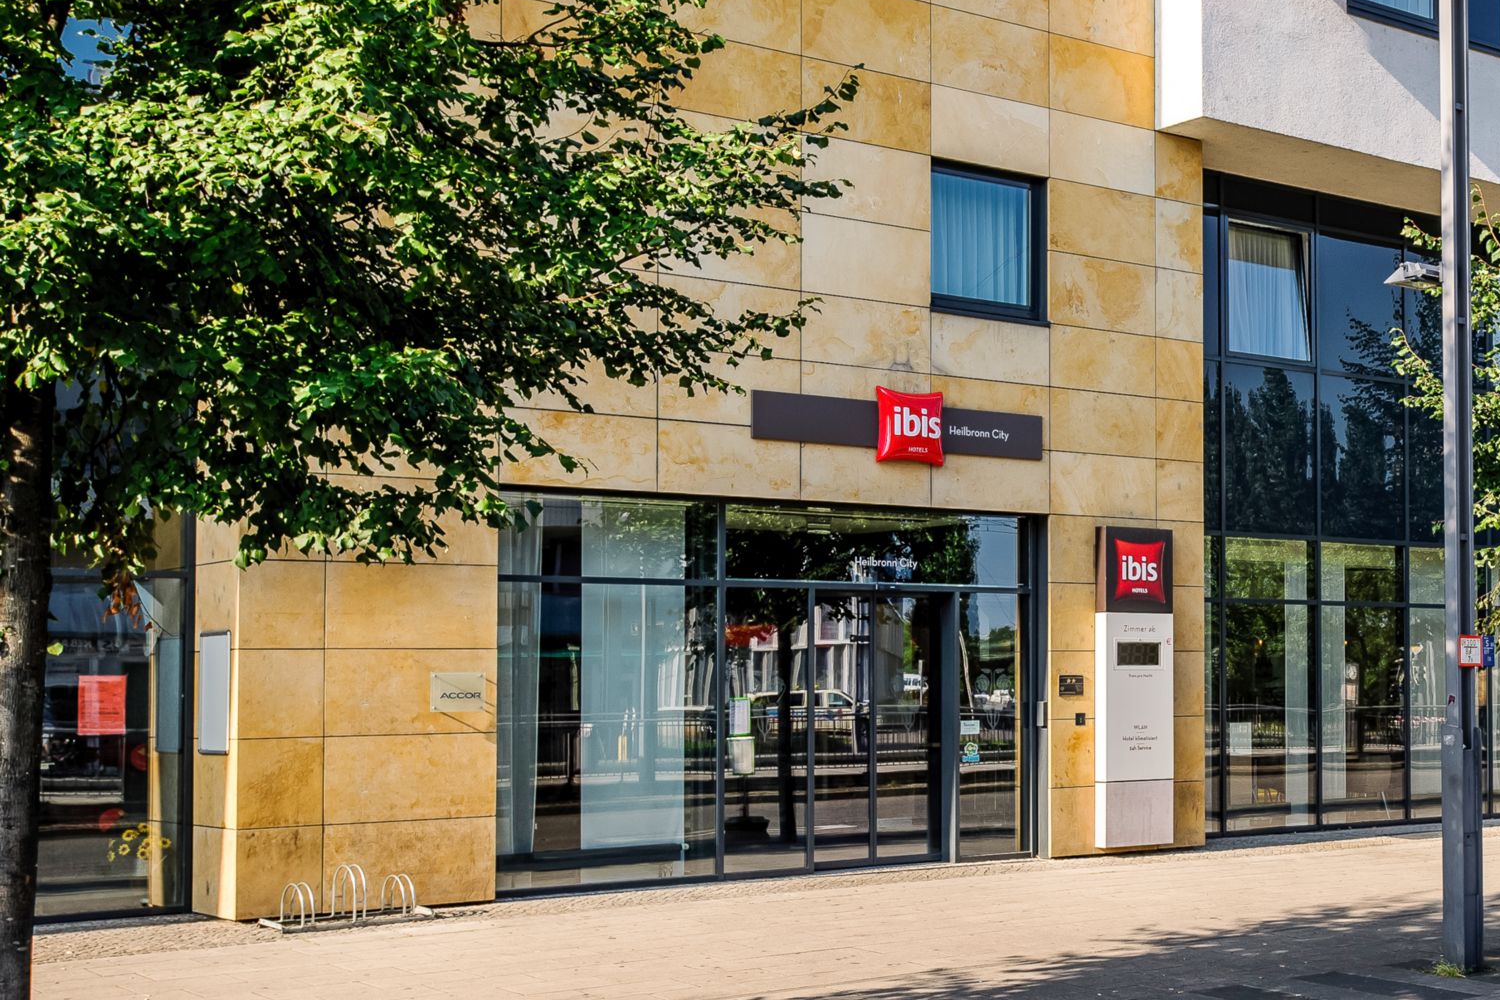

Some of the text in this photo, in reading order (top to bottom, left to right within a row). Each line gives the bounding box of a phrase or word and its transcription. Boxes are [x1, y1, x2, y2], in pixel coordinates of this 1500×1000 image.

[893, 406, 942, 439] ibis
[949, 425, 1010, 442] Heilbronn City
[854, 556, 918, 570] Heilbronn City
[1121, 555, 1158, 582] ibis
[1123, 624, 1147, 633] Zimmer
[439, 691, 482, 700] ACCOR
